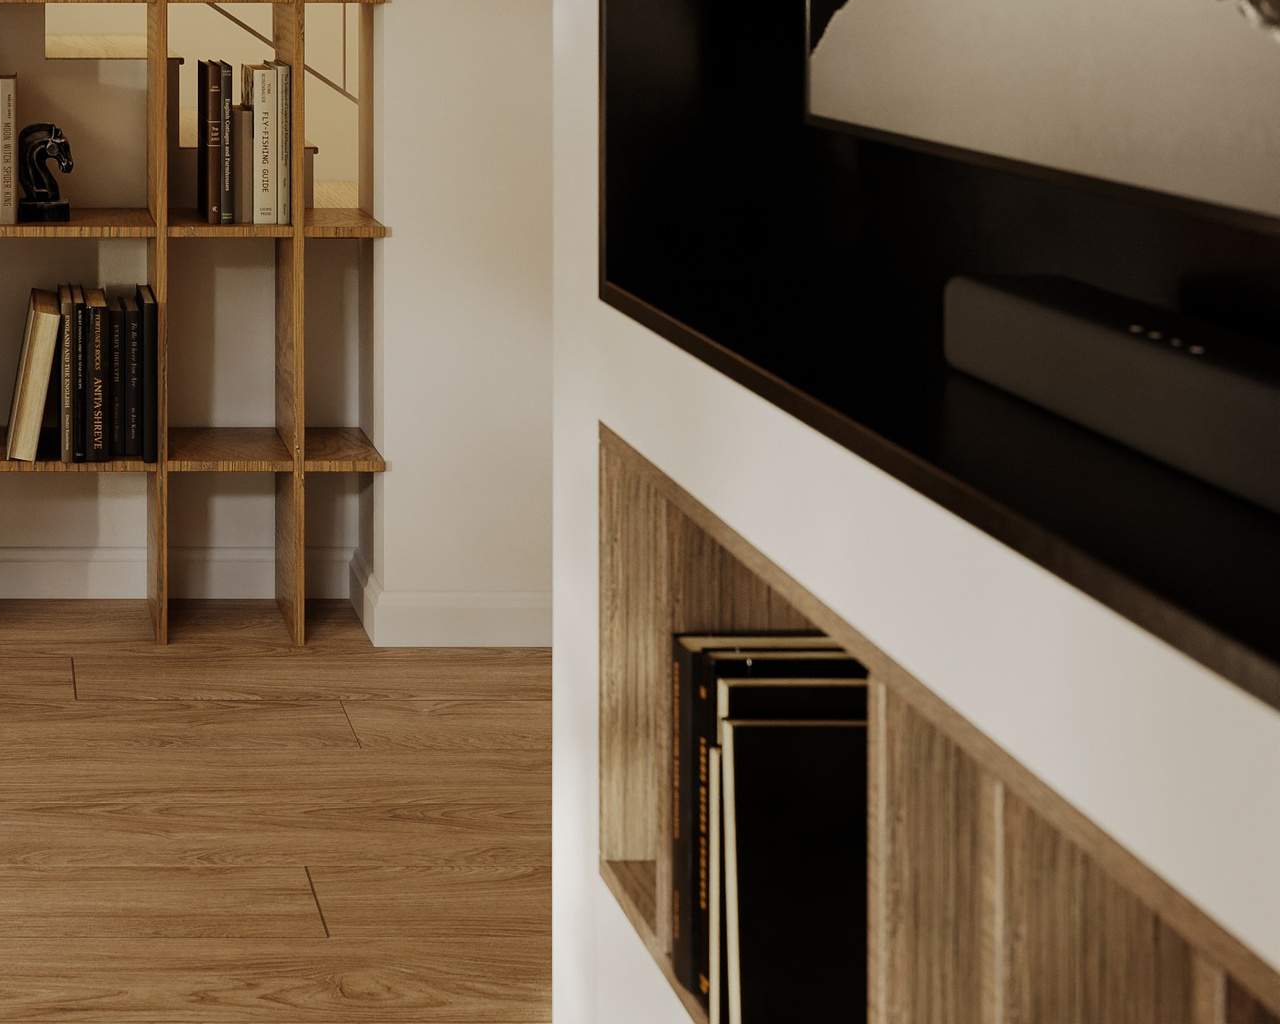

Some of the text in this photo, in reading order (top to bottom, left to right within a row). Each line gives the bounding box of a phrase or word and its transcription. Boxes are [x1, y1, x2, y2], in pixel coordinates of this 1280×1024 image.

[3, 122, 12, 207] MOON WITCH SPIDER KING
[261, 111, 269, 193] FLY-FISHING GUIDE
[93, 377, 103, 450] ANITA SHREVE
